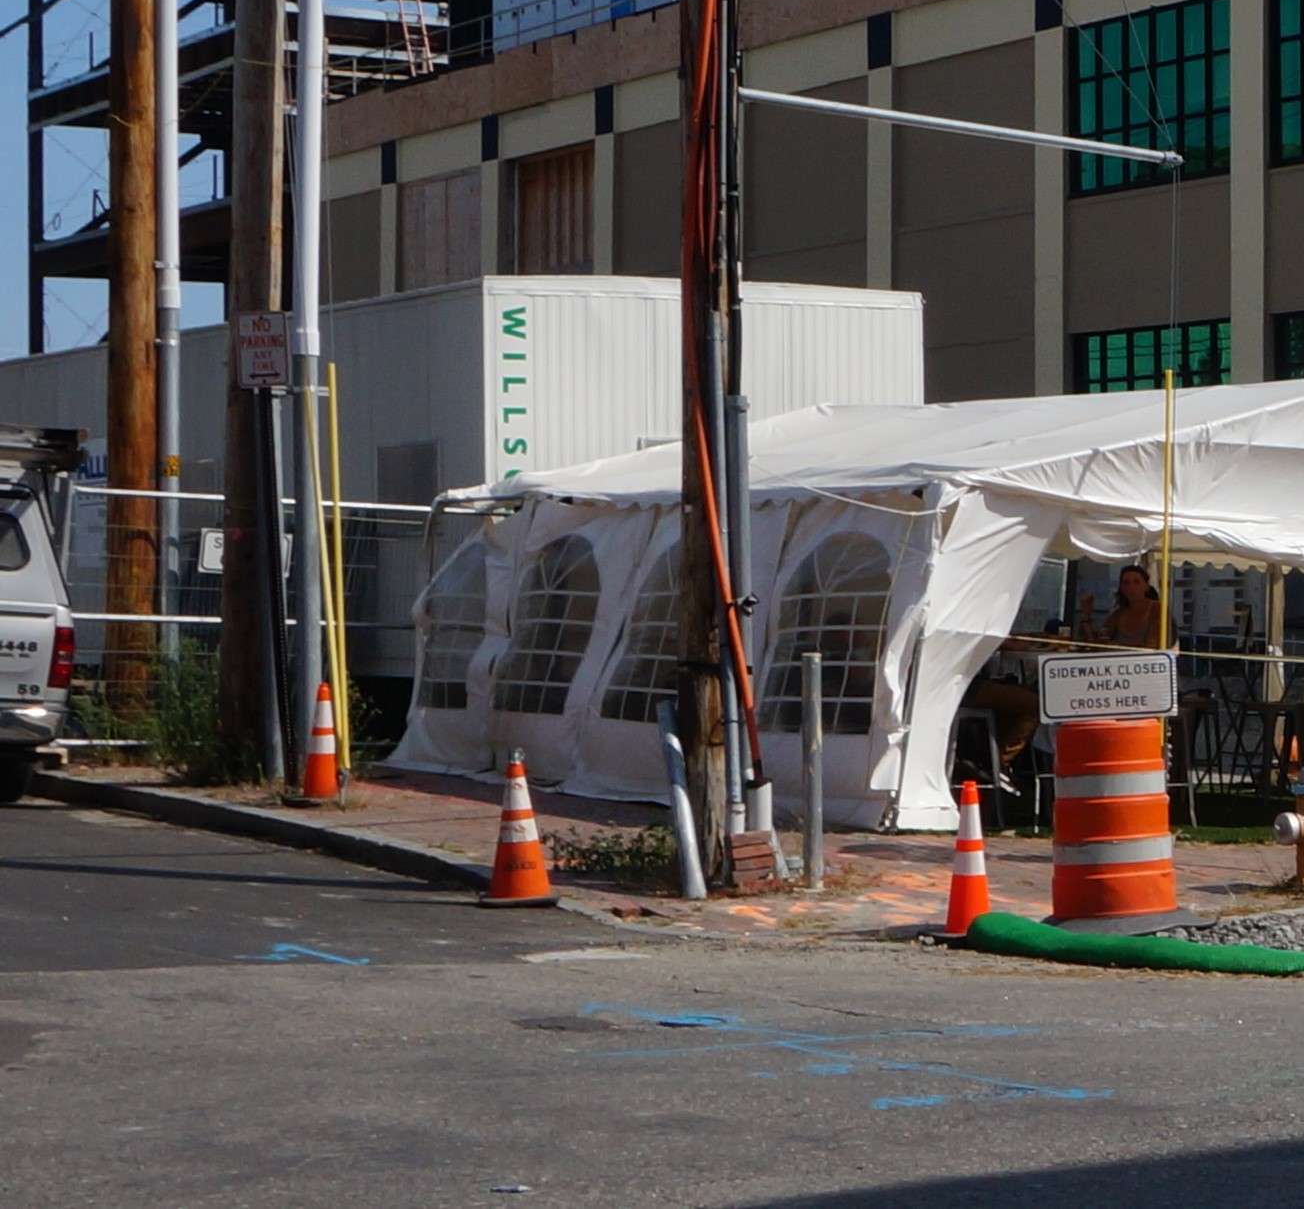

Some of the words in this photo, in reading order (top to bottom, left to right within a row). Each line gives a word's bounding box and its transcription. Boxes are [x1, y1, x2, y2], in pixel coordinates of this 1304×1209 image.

[502, 306, 528, 480] WILLS
[1049, 665, 1112, 679] SIDEWALK
[1118, 662, 1167, 676] CLOSED
[17, 683, 40, 695] 59
[1087, 679, 1130, 692] AHEAD
[1070, 696, 1111, 710] CROSS
[1115, 695, 1148, 707] HERE
